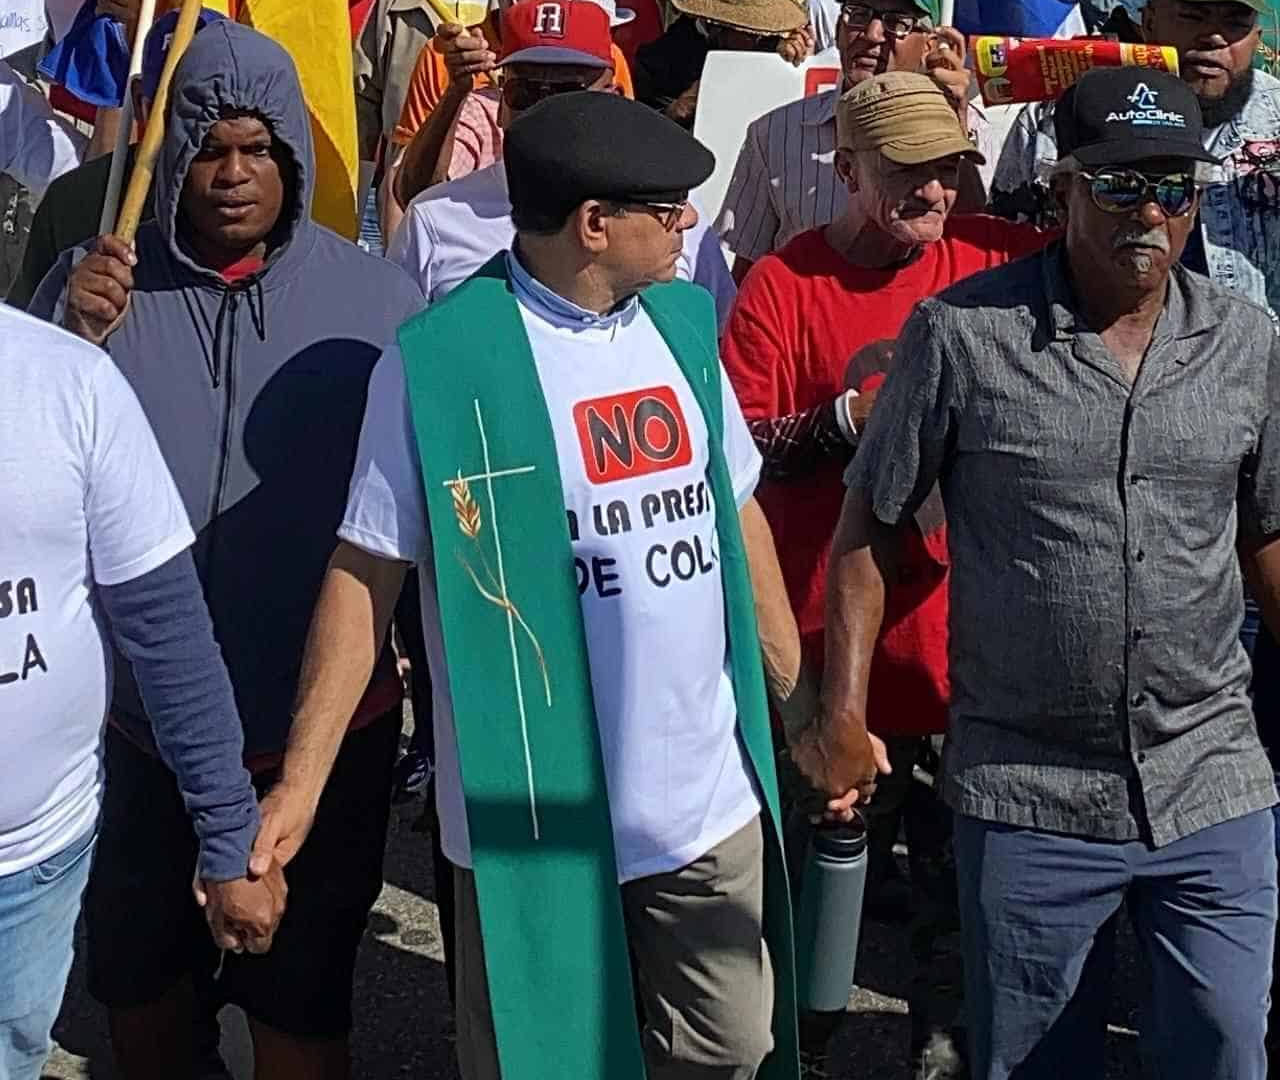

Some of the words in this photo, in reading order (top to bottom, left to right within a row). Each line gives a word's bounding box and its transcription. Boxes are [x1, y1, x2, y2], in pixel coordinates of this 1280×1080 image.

[1105, 108, 1185, 123] AutoClinic
[585, 395, 681, 476] NO
[592, 499, 632, 537] LA
[640, 480, 710, 529] PRES
[645, 534, 718, 588] COL
